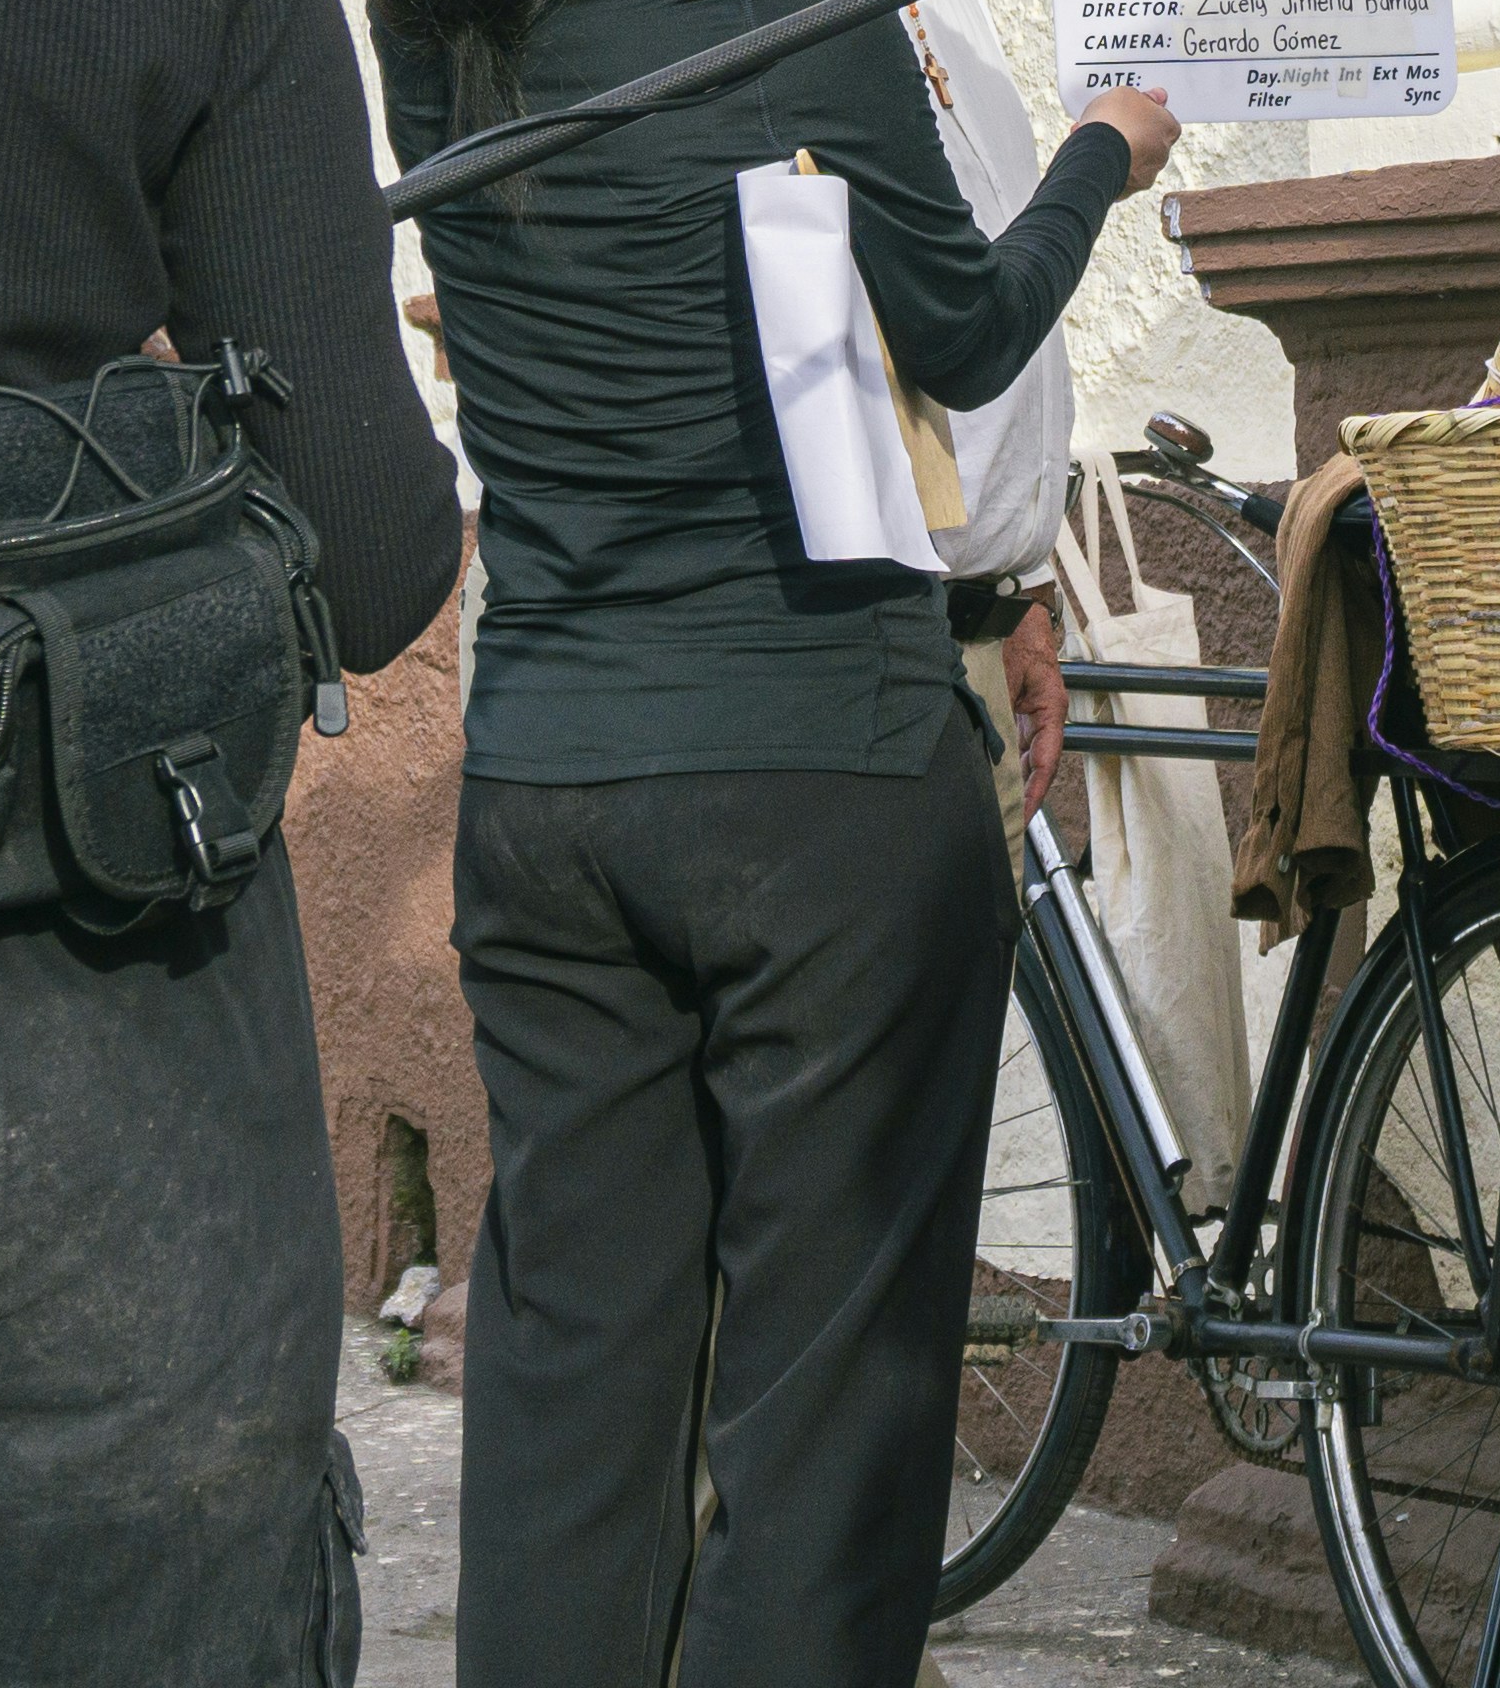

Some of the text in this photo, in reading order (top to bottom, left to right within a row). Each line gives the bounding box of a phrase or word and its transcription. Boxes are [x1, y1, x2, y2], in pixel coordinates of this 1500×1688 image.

[1082, 1, 1185, 18] DIRECTOR:
[1084, 23, 1342, 57] CAMERA: Gerardo Gómez
[1086, 71, 1142, 88] DATE:
[1282, 67, 1330, 88] Night
[1337, 66, 1363, 82] Int
[1372, 66, 1399, 81] Ext
[1406, 65, 1440, 80] Mos
[1248, 87, 1442, 108] Filter Sync
